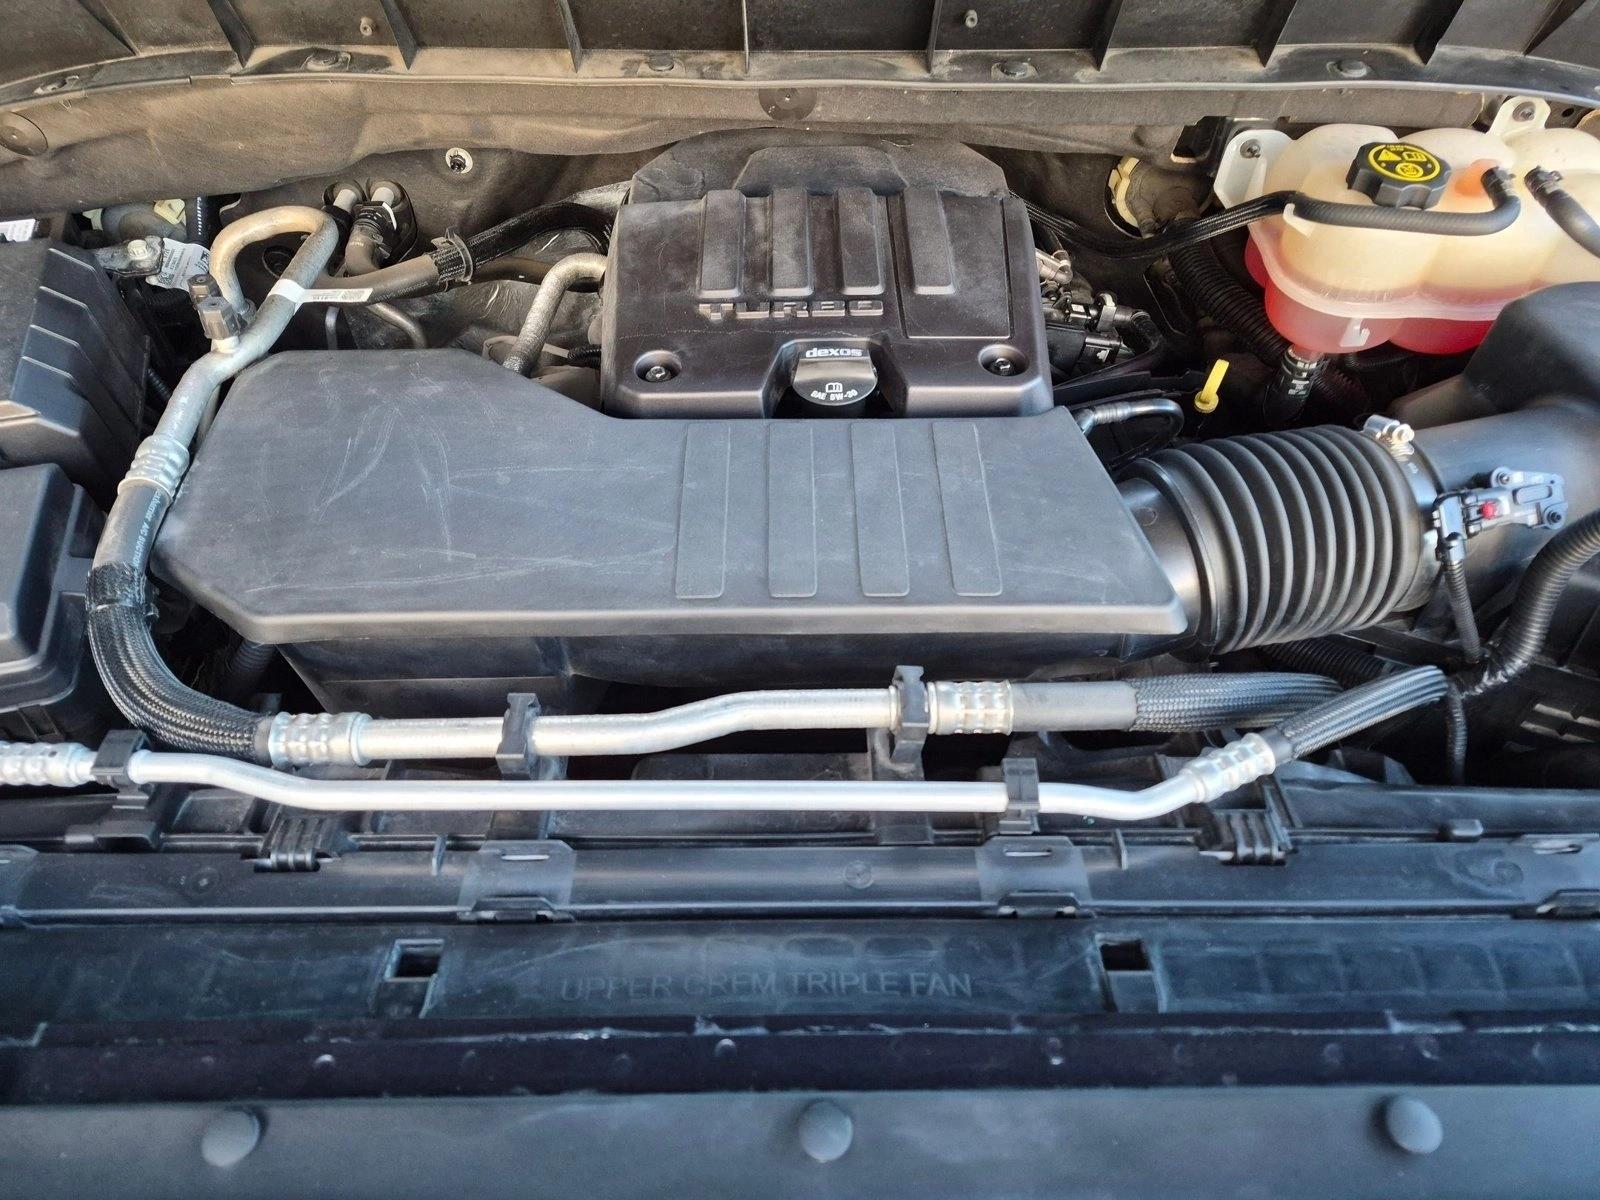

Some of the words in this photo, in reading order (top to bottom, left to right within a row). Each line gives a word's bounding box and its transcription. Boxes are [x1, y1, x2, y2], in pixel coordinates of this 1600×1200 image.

[698, 300, 884, 320] TURBO
[805, 347, 863, 358] dexos
[560, 974, 672, 1000] UPPER
[788, 971, 900, 996] TRIPLE
[909, 972, 972, 998] FAN
